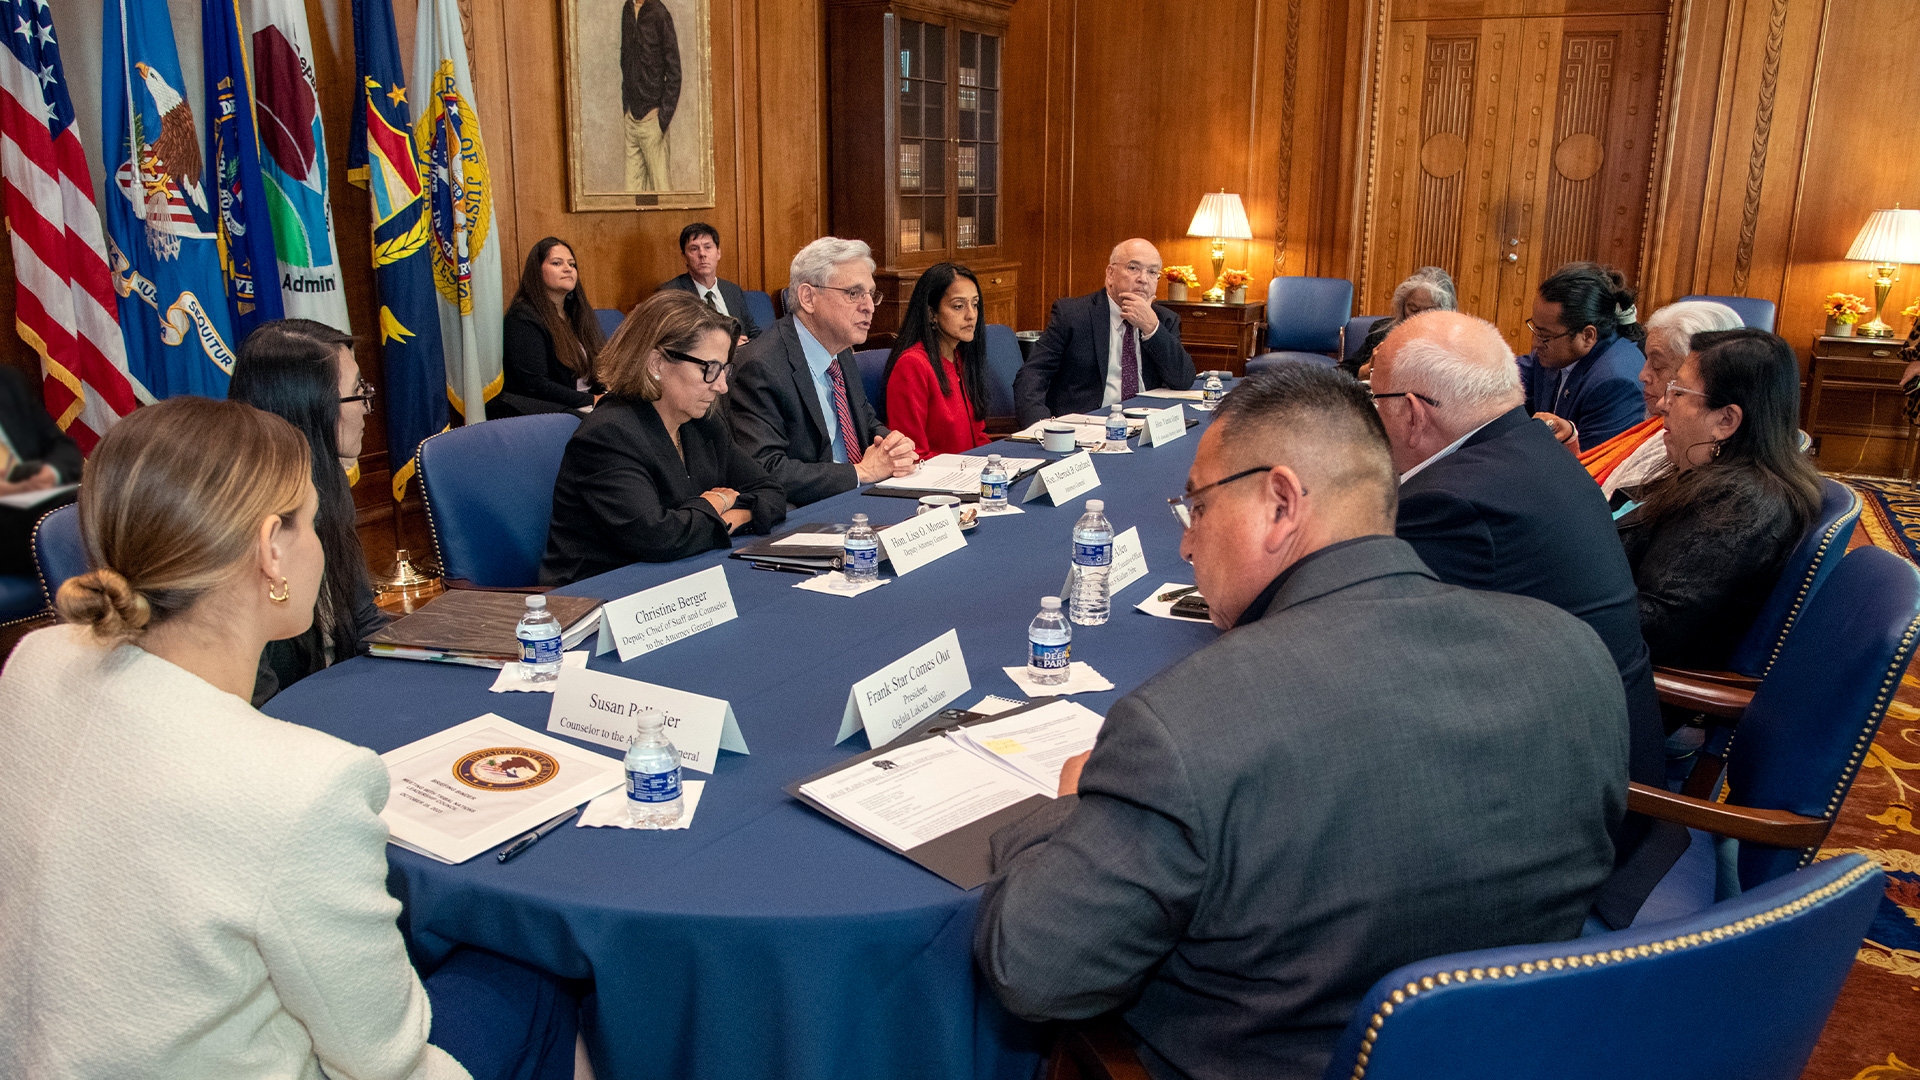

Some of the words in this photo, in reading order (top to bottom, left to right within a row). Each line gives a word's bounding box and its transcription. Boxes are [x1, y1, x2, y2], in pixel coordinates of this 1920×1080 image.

[188, 300, 232, 367] SEQUITUR
[890, 537, 907, 548] Hon.
[905, 531, 920, 542] Lisa
[925, 518, 950, 533] Monaco
[622, 633, 645, 646] Deputy
[645, 624, 664, 637] Chief
[664, 620, 672, 631] of
[671, 615, 687, 628] Staff
[687, 610, 699, 621] and
[698, 600, 728, 617] Counselor
[635, 602, 677, 625] Christine
[677, 591, 708, 610] Berger
[645, 642, 654, 650] to
[653, 637, 664, 649] the
[665, 630, 691, 645] Attorney
[690, 617, 714, 633] General
[1043, 659, 1068, 668] PARK
[1044, 651, 1067, 660] DEER
[866, 682, 892, 707] Frank
[891, 673, 909, 692] Star
[908, 658, 936, 681] Comes
[935, 649, 951, 665] Out
[902, 684, 929, 705] President
[589, 693, 625, 715] Susan
[891, 712, 911, 730] Oglala
[909, 701, 929, 718] Lakota
[927, 689, 947, 707] Nation
[560, 716, 600, 738] Counselor
[601, 728, 610, 739] to
[611, 729, 625, 743] the
[678, 750, 700, 762] neral
[430, 779, 456, 791] BRIEFING
[455, 790, 477, 800] BINDER
